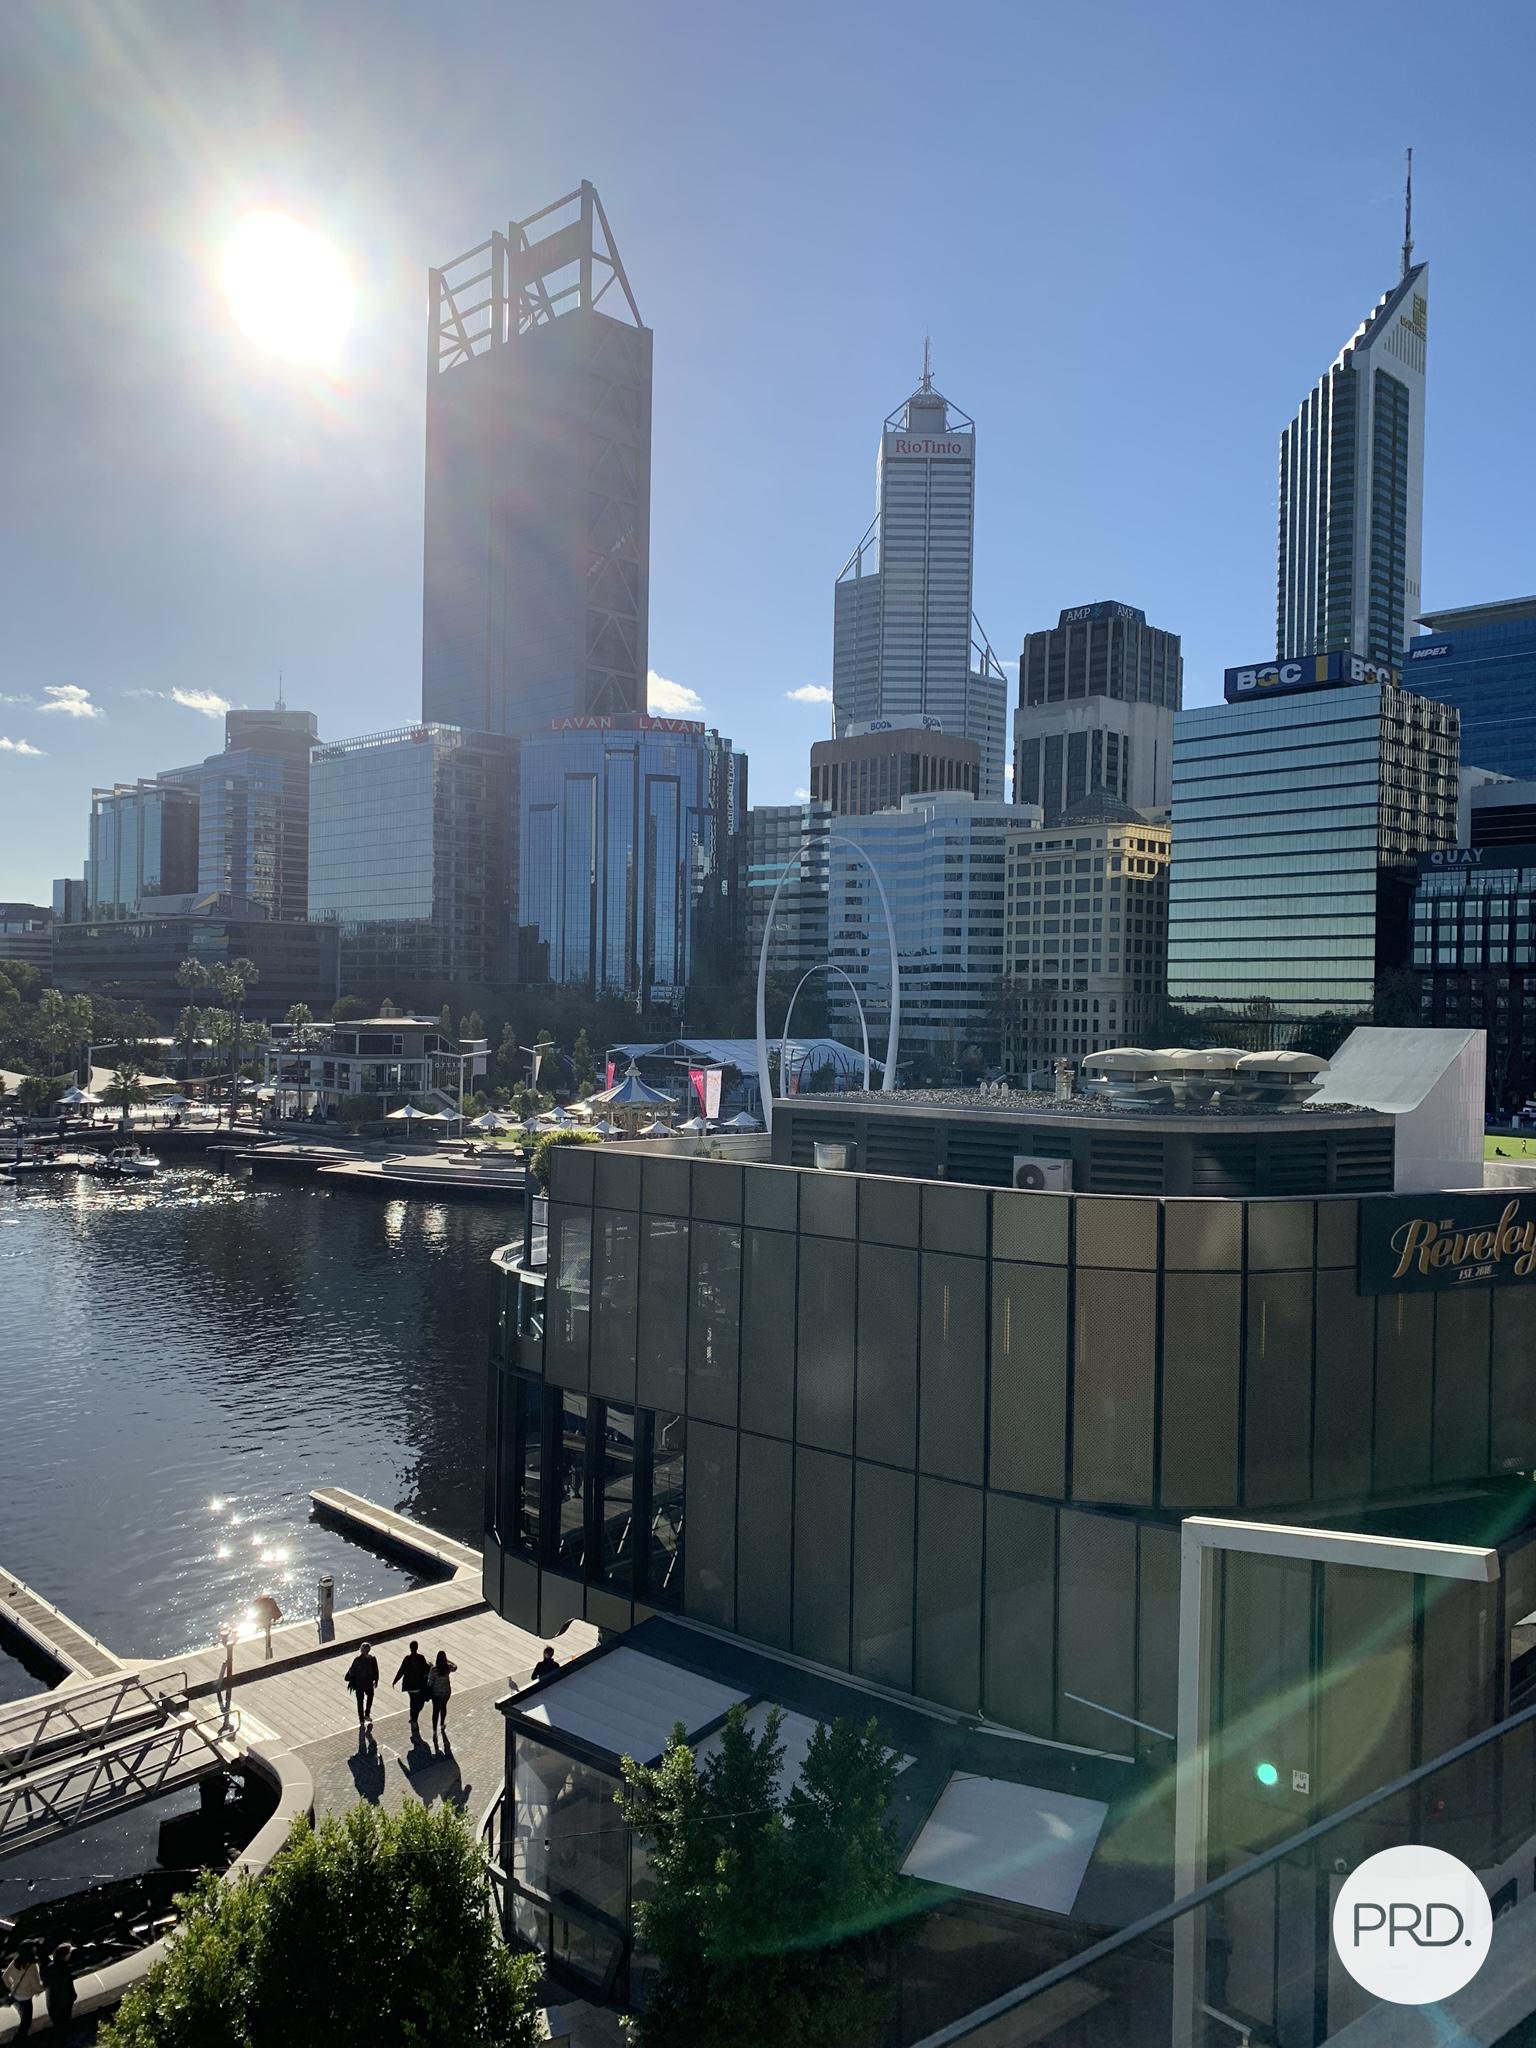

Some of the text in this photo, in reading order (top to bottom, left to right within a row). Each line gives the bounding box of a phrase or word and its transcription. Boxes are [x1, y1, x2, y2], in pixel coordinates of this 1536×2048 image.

[1066, 607, 1090, 621] AMP
[1117, 605, 1134, 619] AMP
[1412, 646, 1448, 660] INPEX
[1236, 663, 1302, 691] BGC
[551, 717, 612, 730] LAVAN
[639, 717, 702, 733] LAVAN
[1430, 848, 1483, 865] QUAY
